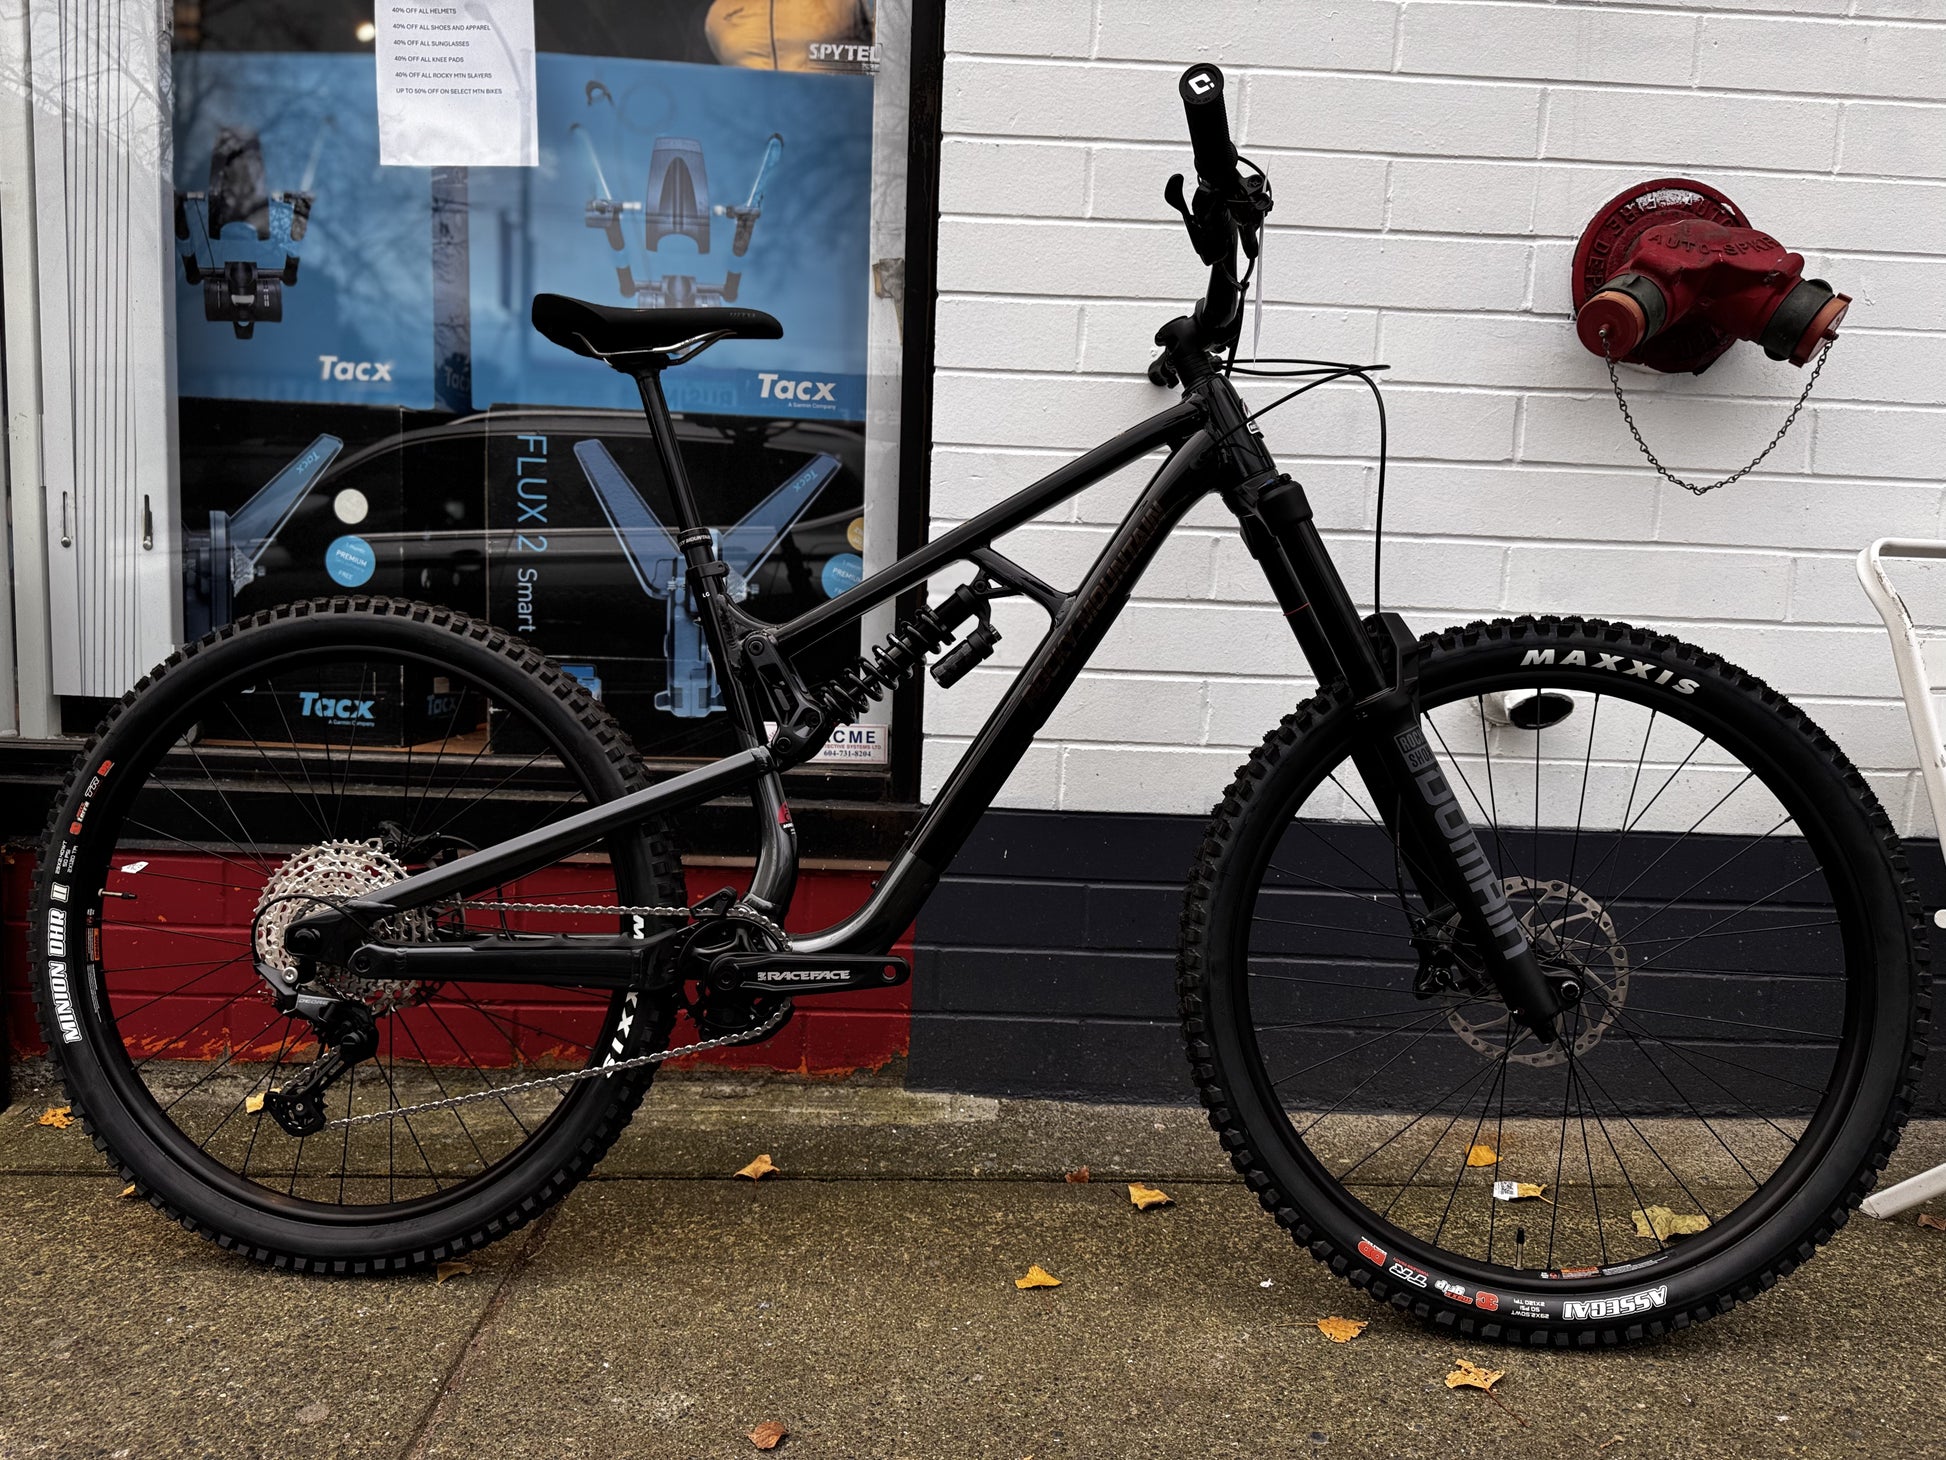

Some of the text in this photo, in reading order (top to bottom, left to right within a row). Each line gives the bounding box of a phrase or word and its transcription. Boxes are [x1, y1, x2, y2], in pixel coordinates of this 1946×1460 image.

[1647, 234, 1781, 256] AUTO-SPKR
[319, 355, 392, 382] Tacx
[758, 373, 836, 401] Tacx
[296, 451, 321, 475] Tacx
[516, 435, 548, 632] FLUX 2 Smart
[335, 549, 368, 567] PREMIUM
[1520, 649, 1700, 695] MAXXIS
[299, 691, 375, 719] Tacx
[827, 730, 876, 744] CME
[1415, 767, 1528, 960] DOMAIN
[48, 908, 67, 958] DHR
[767, 970, 851, 981] RACEFACE
[49, 961, 82, 1043] MINION
[1389, 1263, 1428, 1288] TR
[1435, 1280, 1466, 1296] grip
[1527, 1299, 1546, 1307] 2X120
[1562, 1285, 1667, 1321] ASSEGAI
